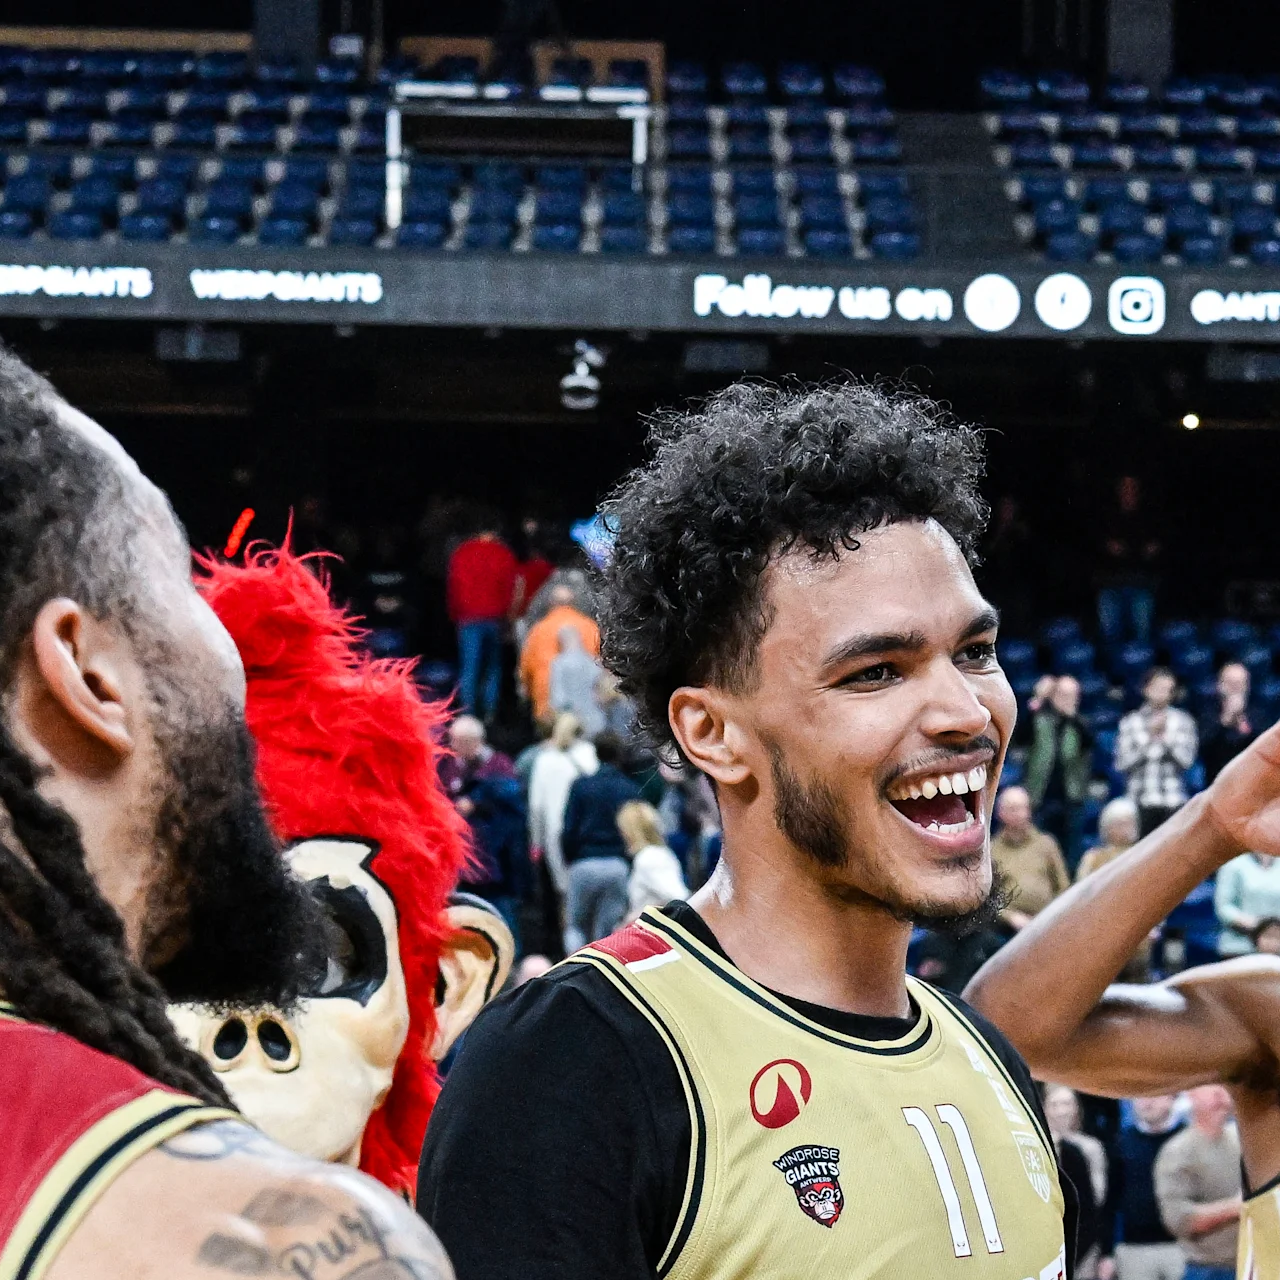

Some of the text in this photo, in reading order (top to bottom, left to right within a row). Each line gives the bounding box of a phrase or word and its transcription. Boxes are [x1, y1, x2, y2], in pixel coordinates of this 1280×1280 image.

[693, 273, 953, 322] Follow us on
[774, 1147, 839, 1170] WINDROSE
[785, 1161, 840, 1185] GIANTS
[799, 1176, 832, 1189] ANTWERP
[901, 1103, 1005, 1259] 11
